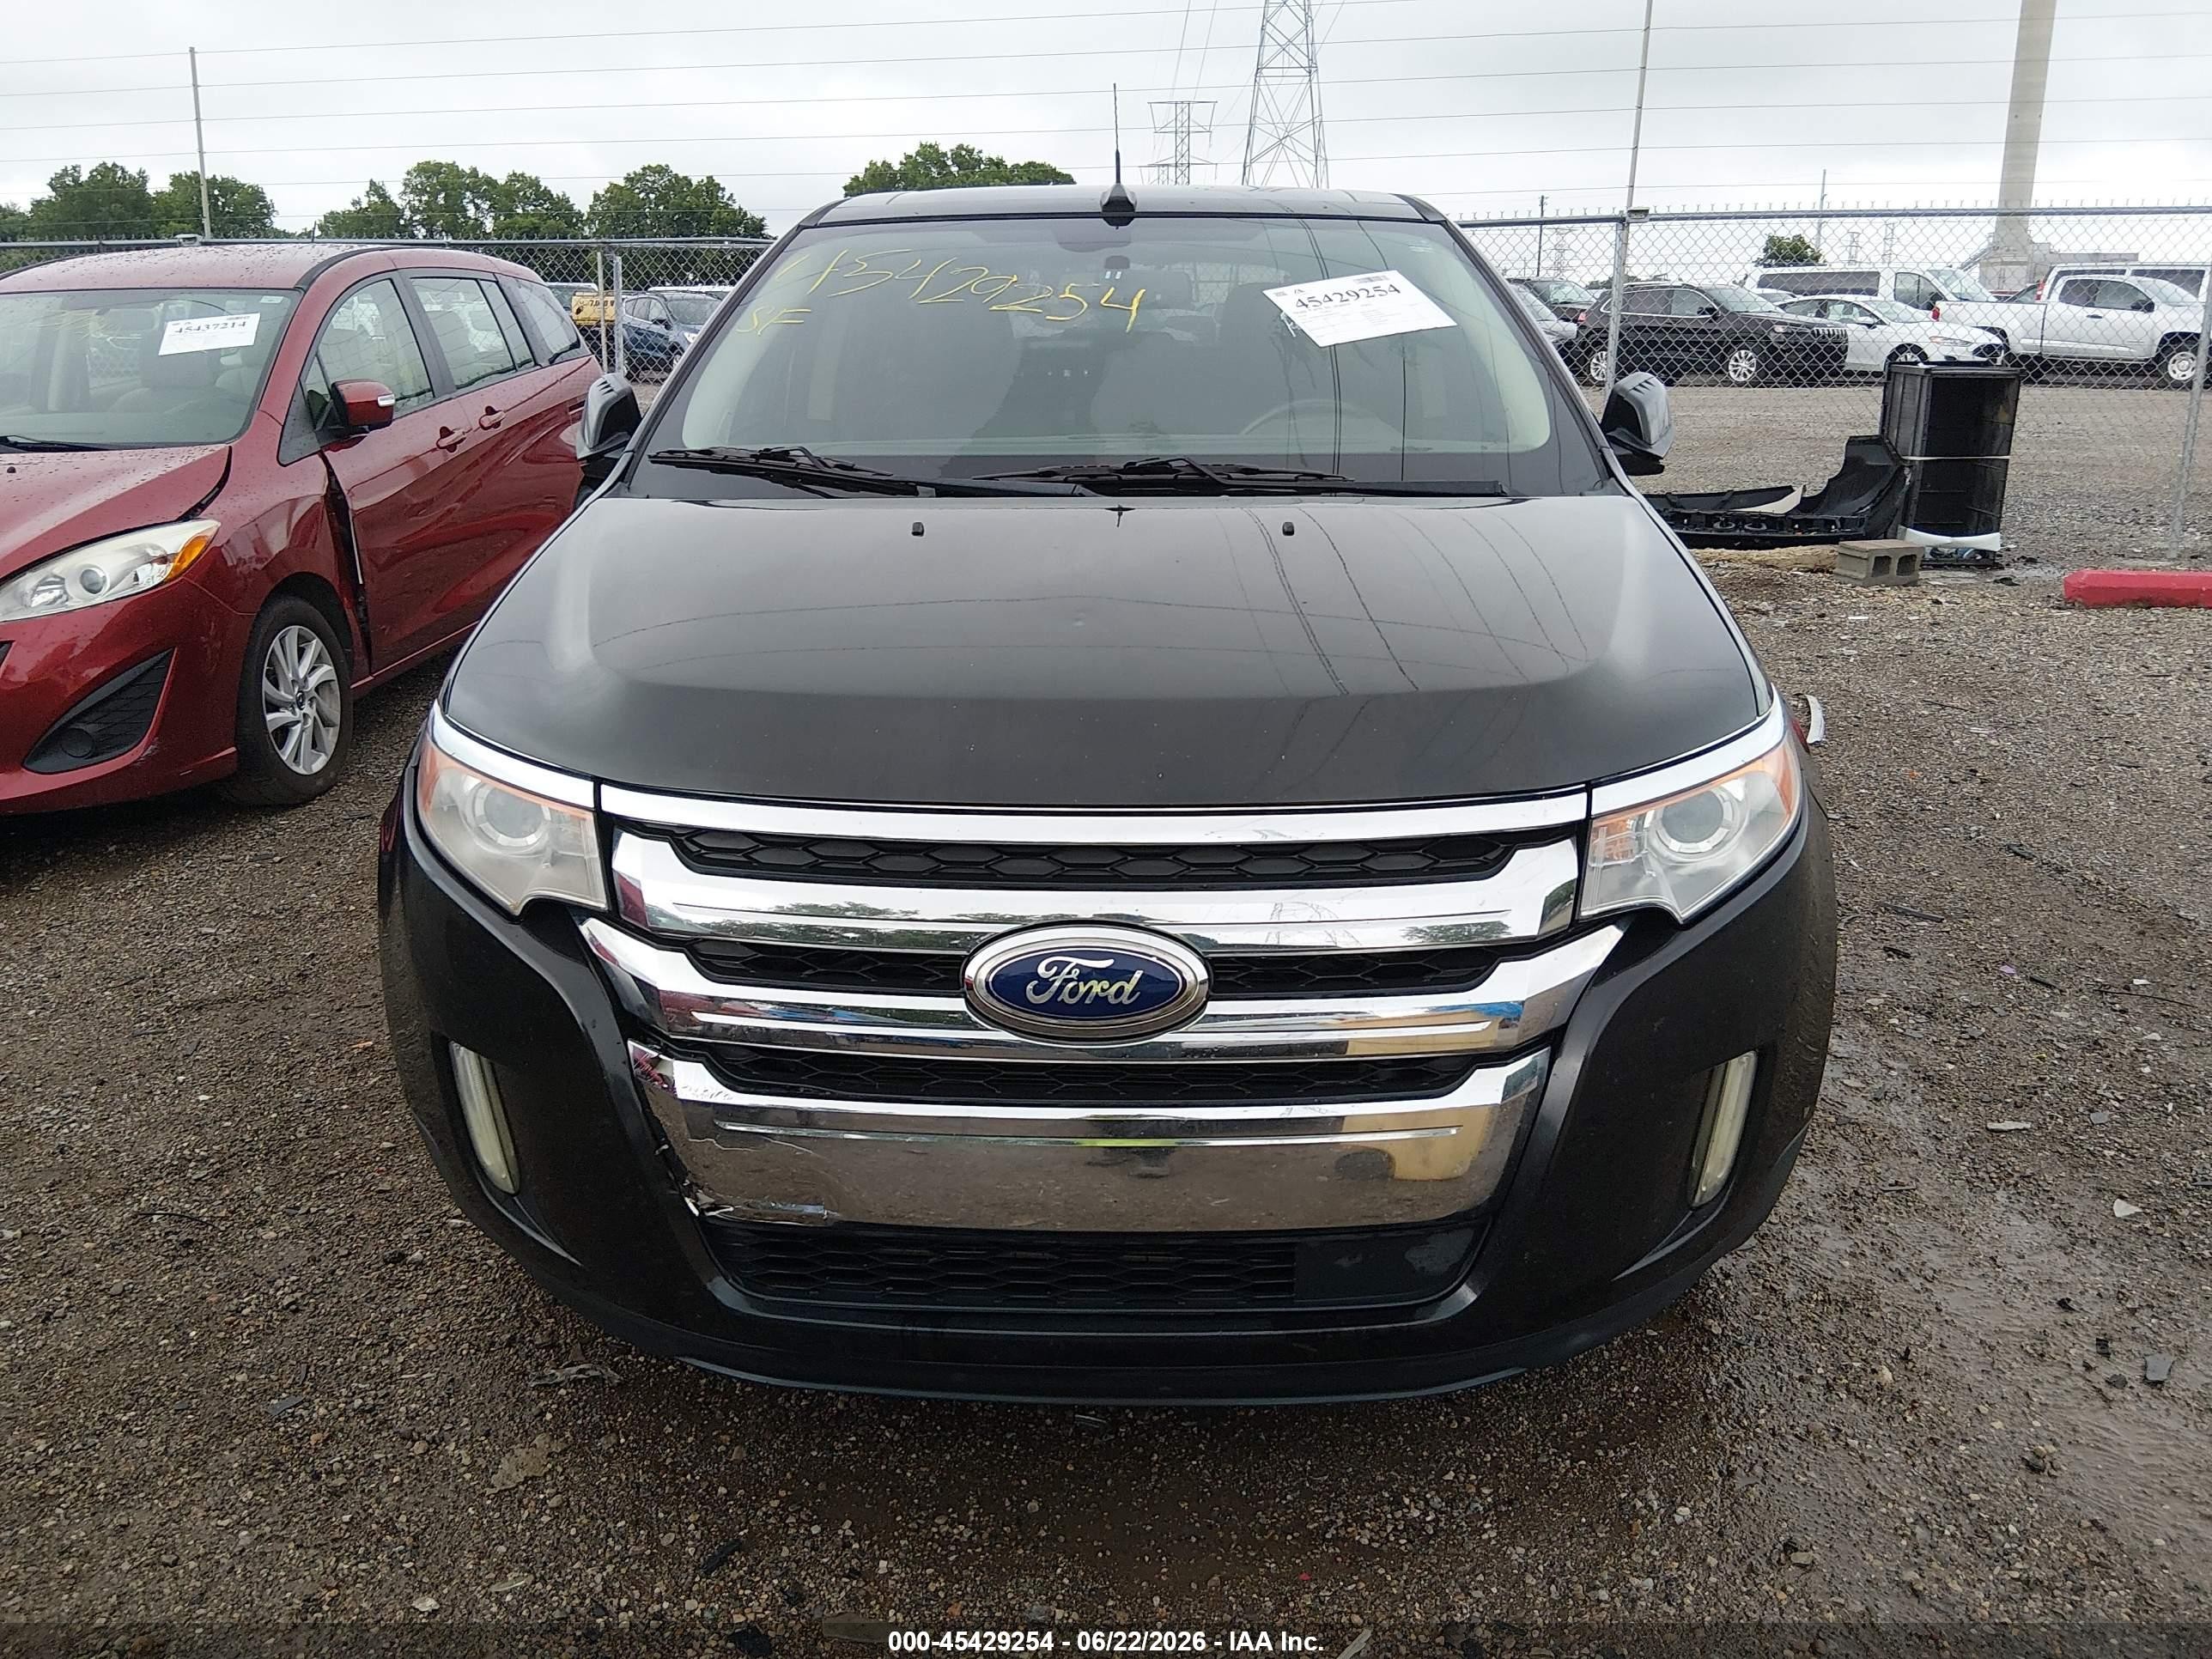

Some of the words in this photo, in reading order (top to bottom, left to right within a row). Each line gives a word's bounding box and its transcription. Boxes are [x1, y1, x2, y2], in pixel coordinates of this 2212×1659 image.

[775, 249, 1146, 334] 45429254
[1295, 283, 1401, 309] 45429254
[175, 321, 246, 333] 45437214
[1025, 956, 1145, 1005] Ford
